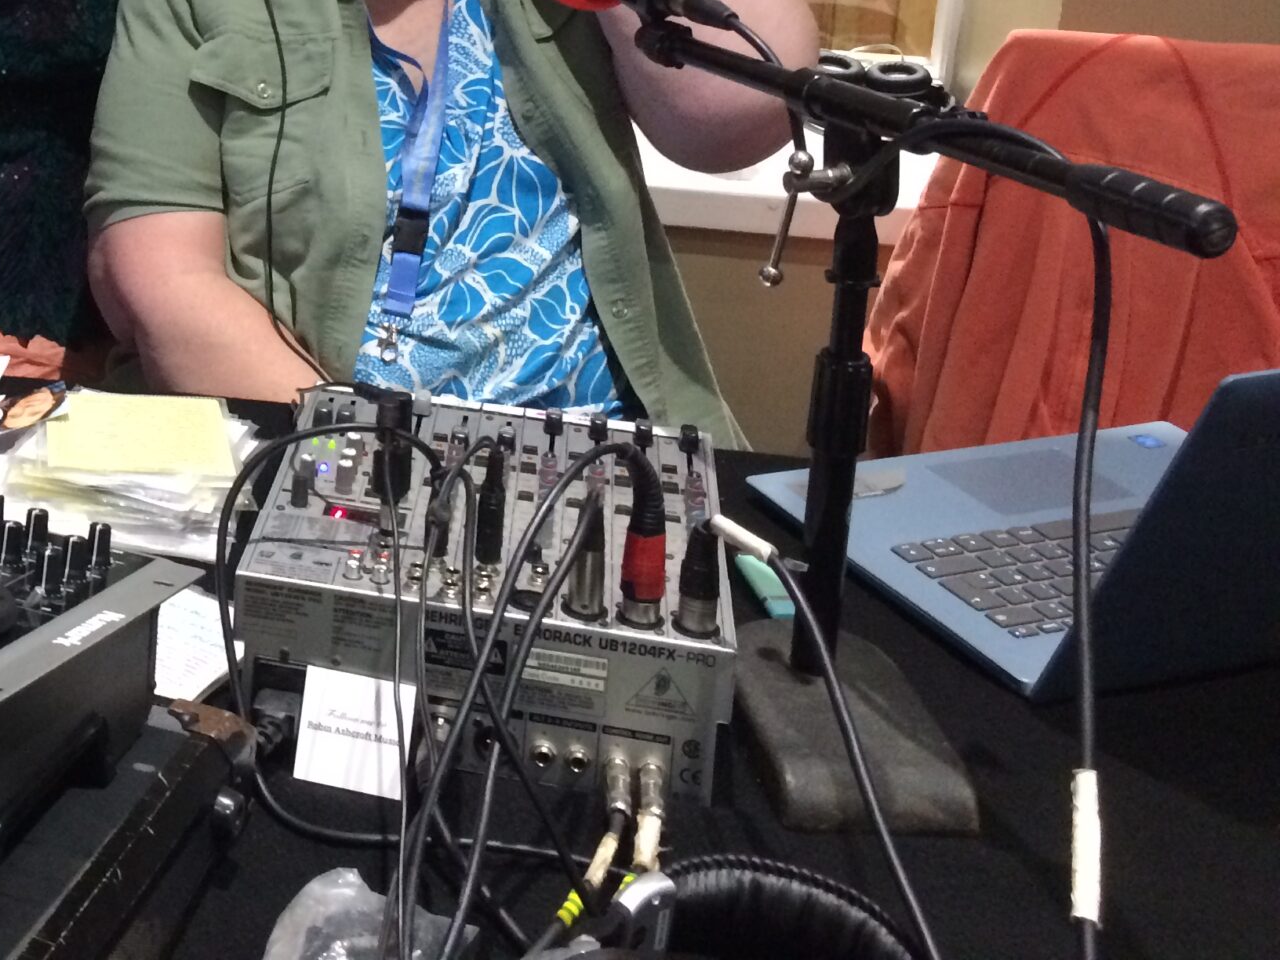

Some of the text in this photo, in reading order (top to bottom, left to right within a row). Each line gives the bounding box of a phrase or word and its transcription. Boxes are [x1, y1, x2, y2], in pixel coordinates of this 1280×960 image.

[424, 609, 502, 633] EHRIGE
[514, 624, 592, 647] EORACK
[598, 637, 716, 668] UB1204FX-PRO
